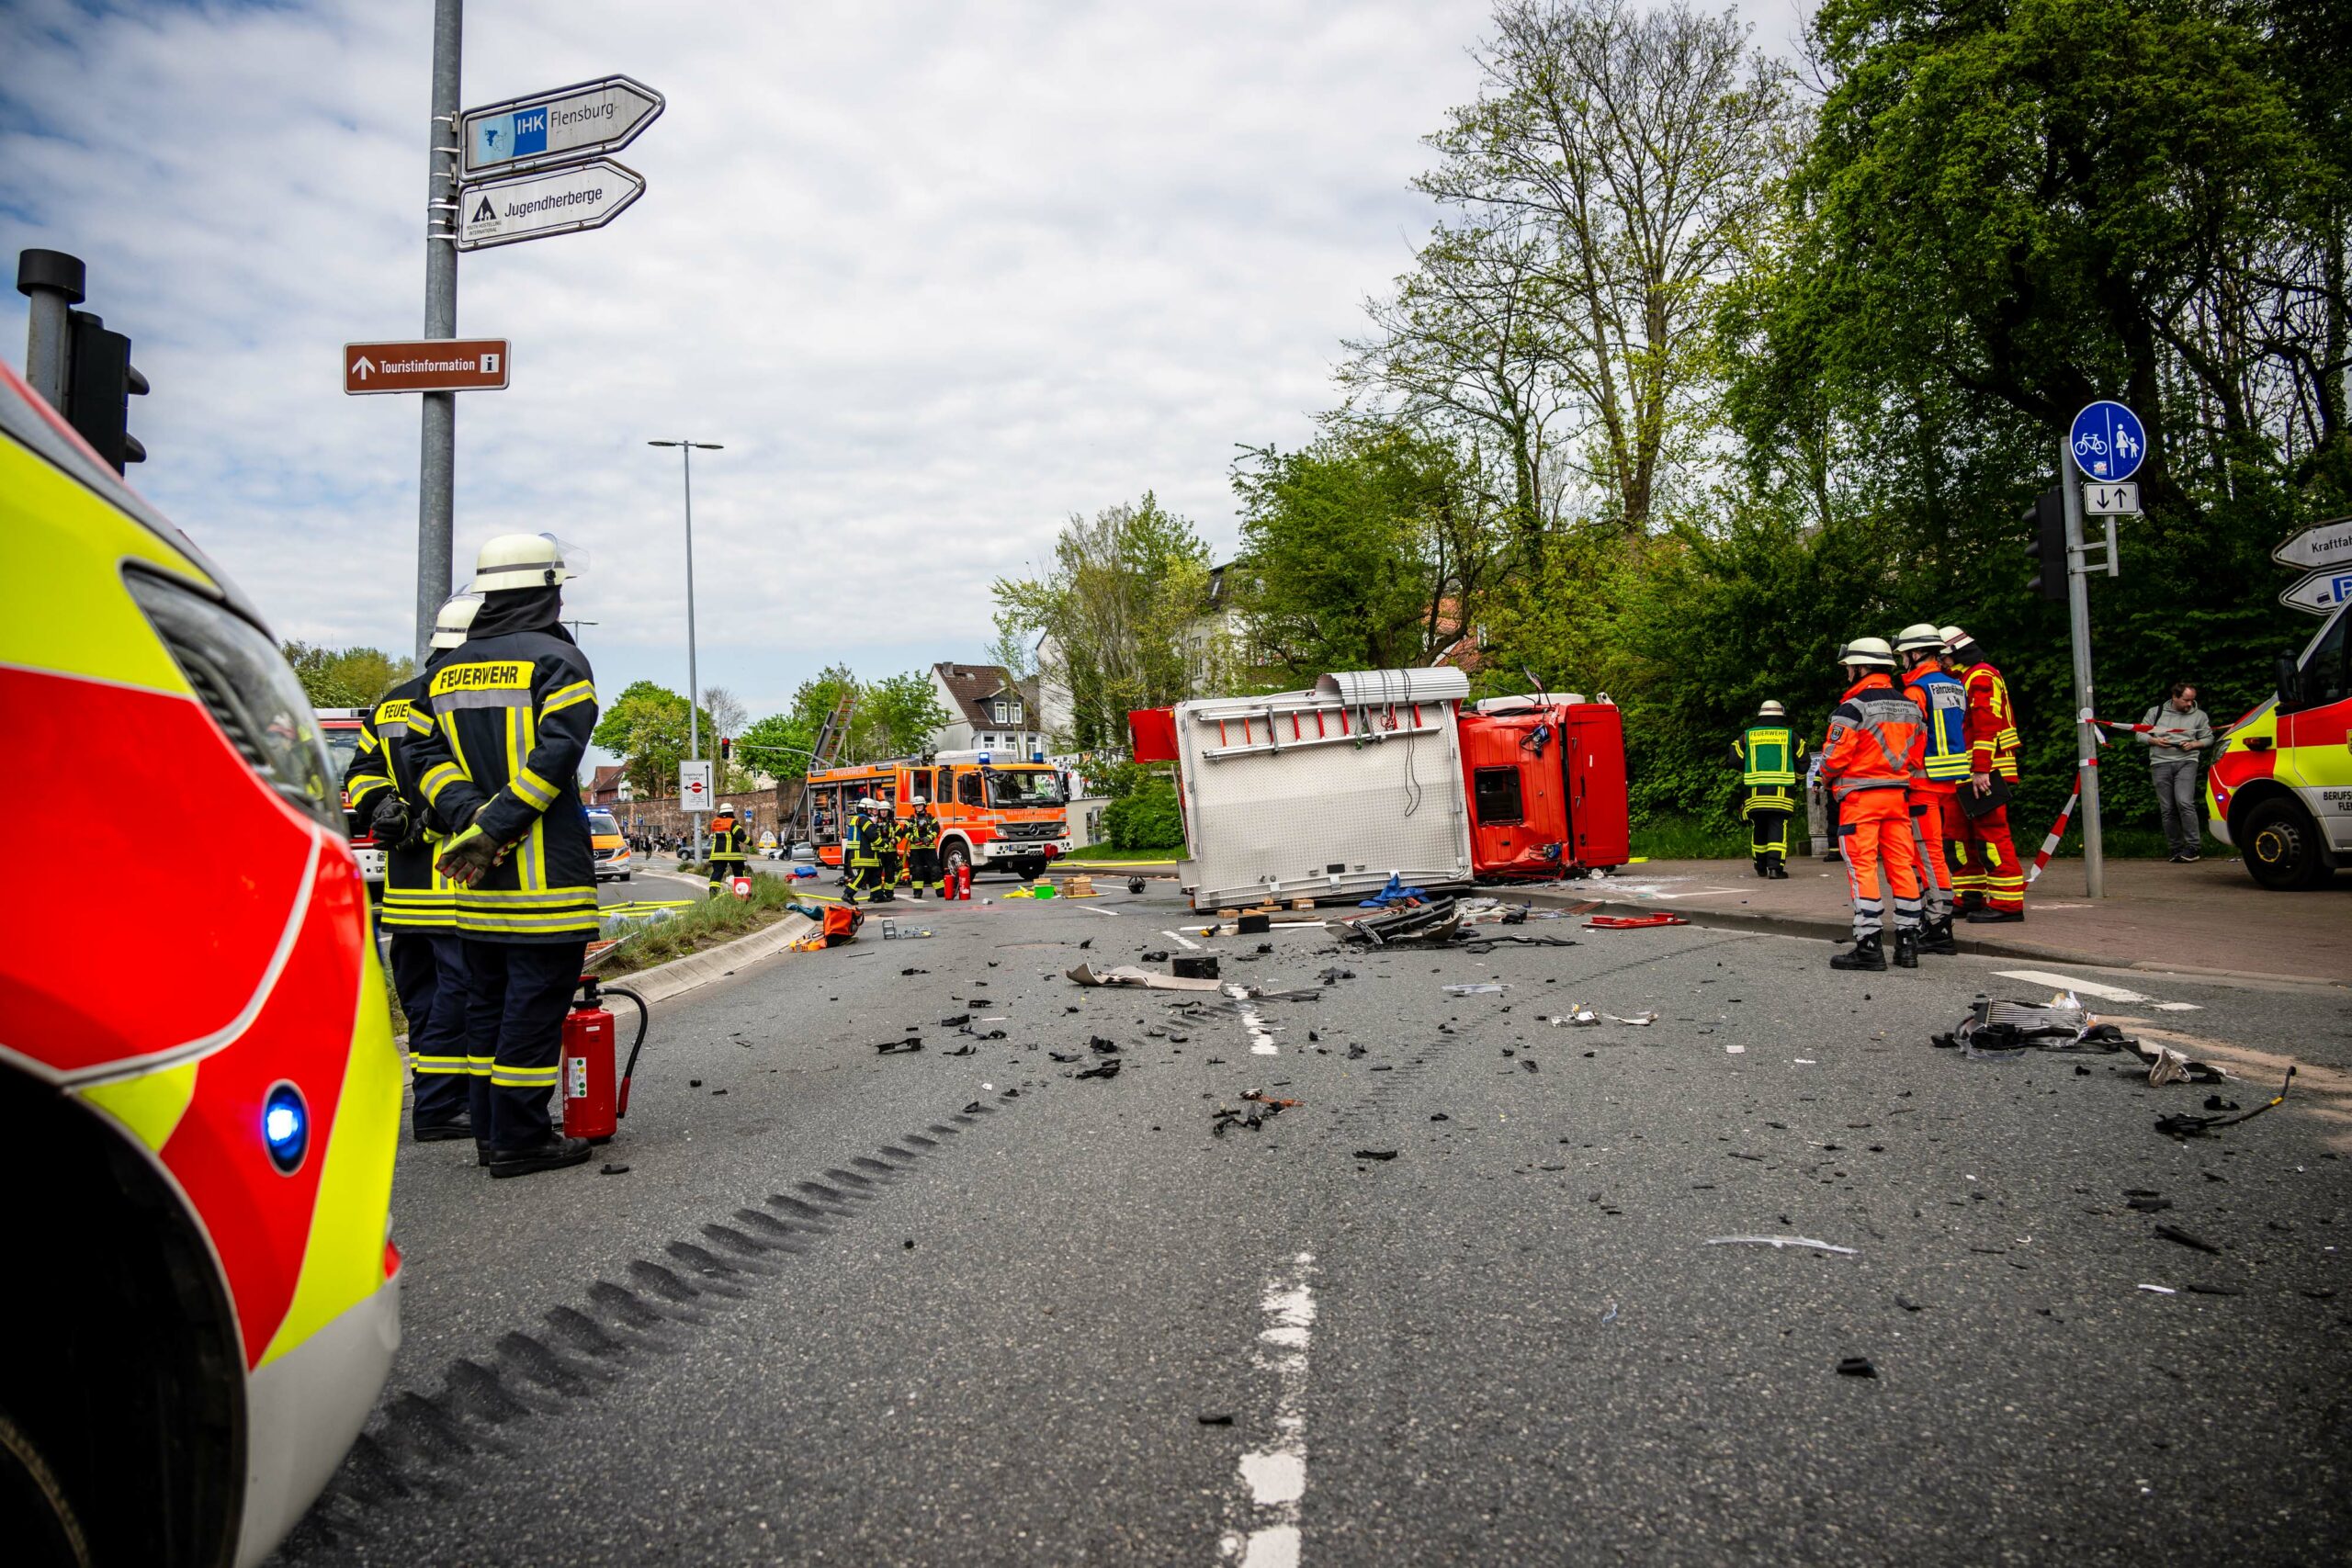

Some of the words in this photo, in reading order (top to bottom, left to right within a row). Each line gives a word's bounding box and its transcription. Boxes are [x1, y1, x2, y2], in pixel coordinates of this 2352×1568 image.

[517, 114, 545, 135] IHK
[551, 102, 614, 128] Flensburg
[504, 187, 603, 218] Jugendherberge
[380, 358, 475, 374] Touristinformation
[440, 666, 518, 689] FEUERWEHR
[384, 704, 409, 719] FEUE
